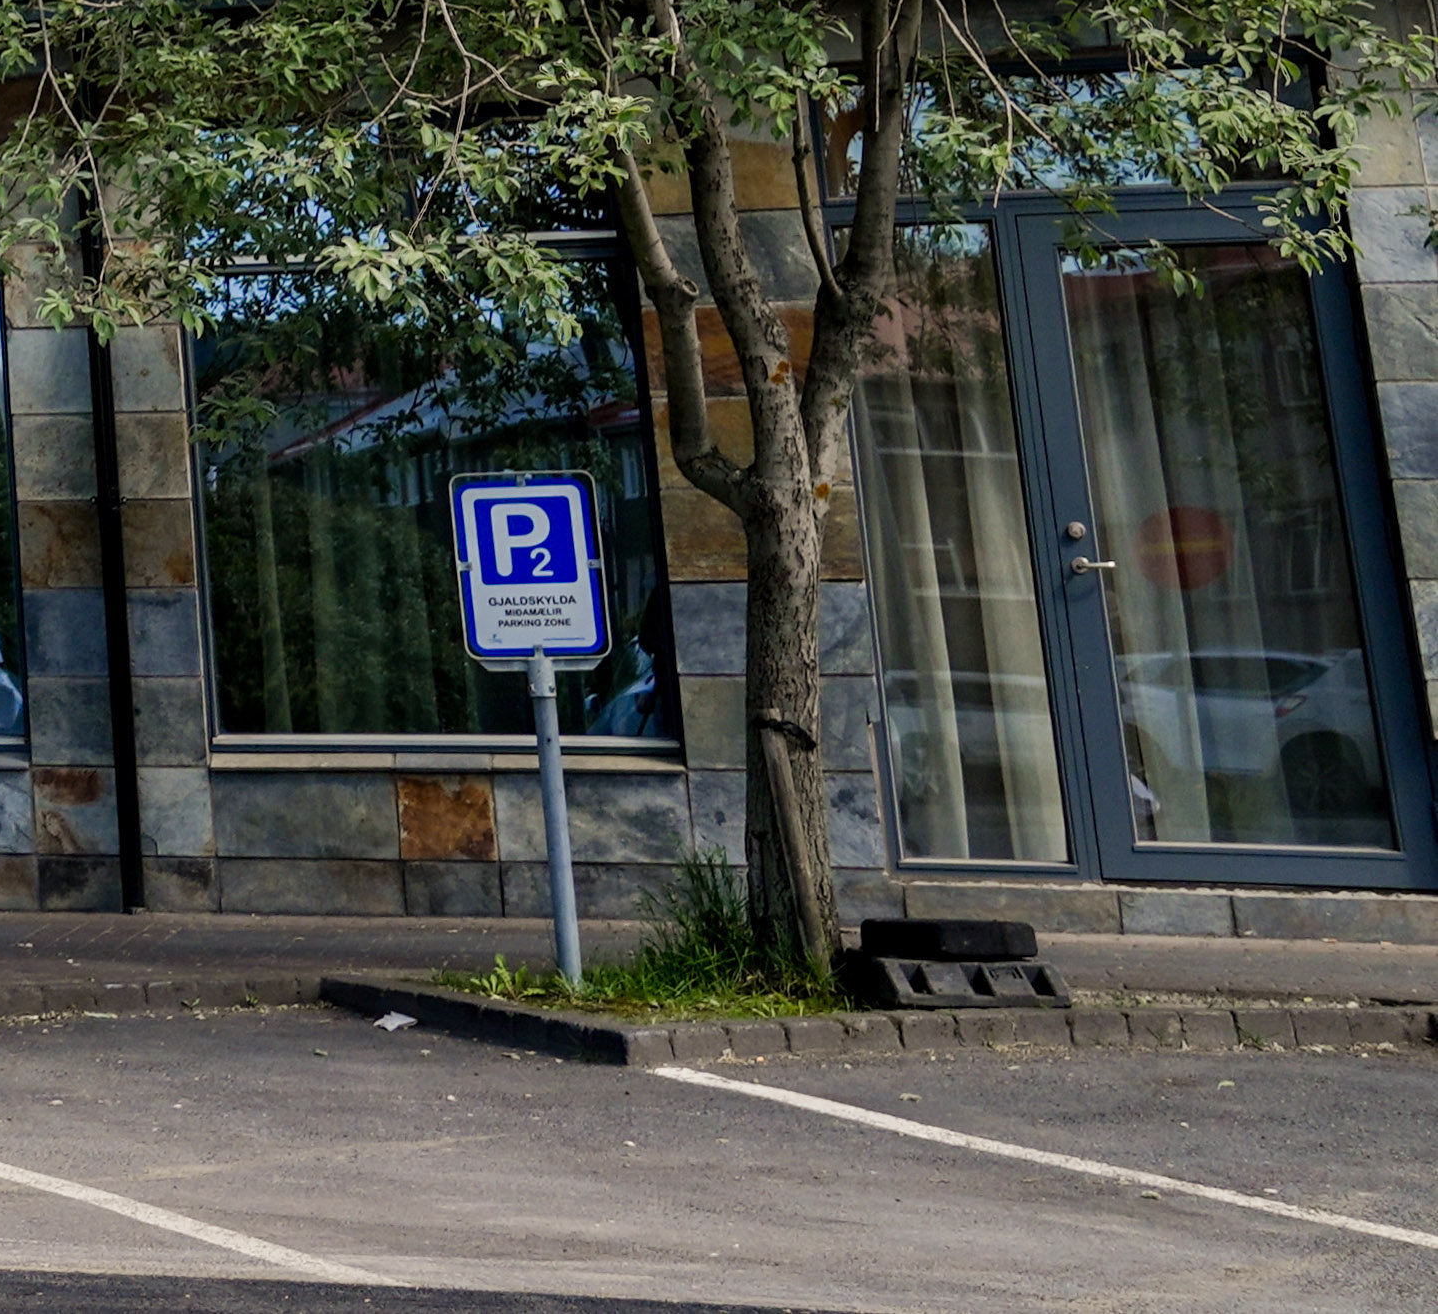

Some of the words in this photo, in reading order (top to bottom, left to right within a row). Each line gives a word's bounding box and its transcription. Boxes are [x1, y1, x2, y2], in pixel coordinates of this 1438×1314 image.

[488, 594, 577, 607] GJALDSKYLDA
[498, 619, 542, 628] PARKING
[544, 618, 572, 627] ZONE
